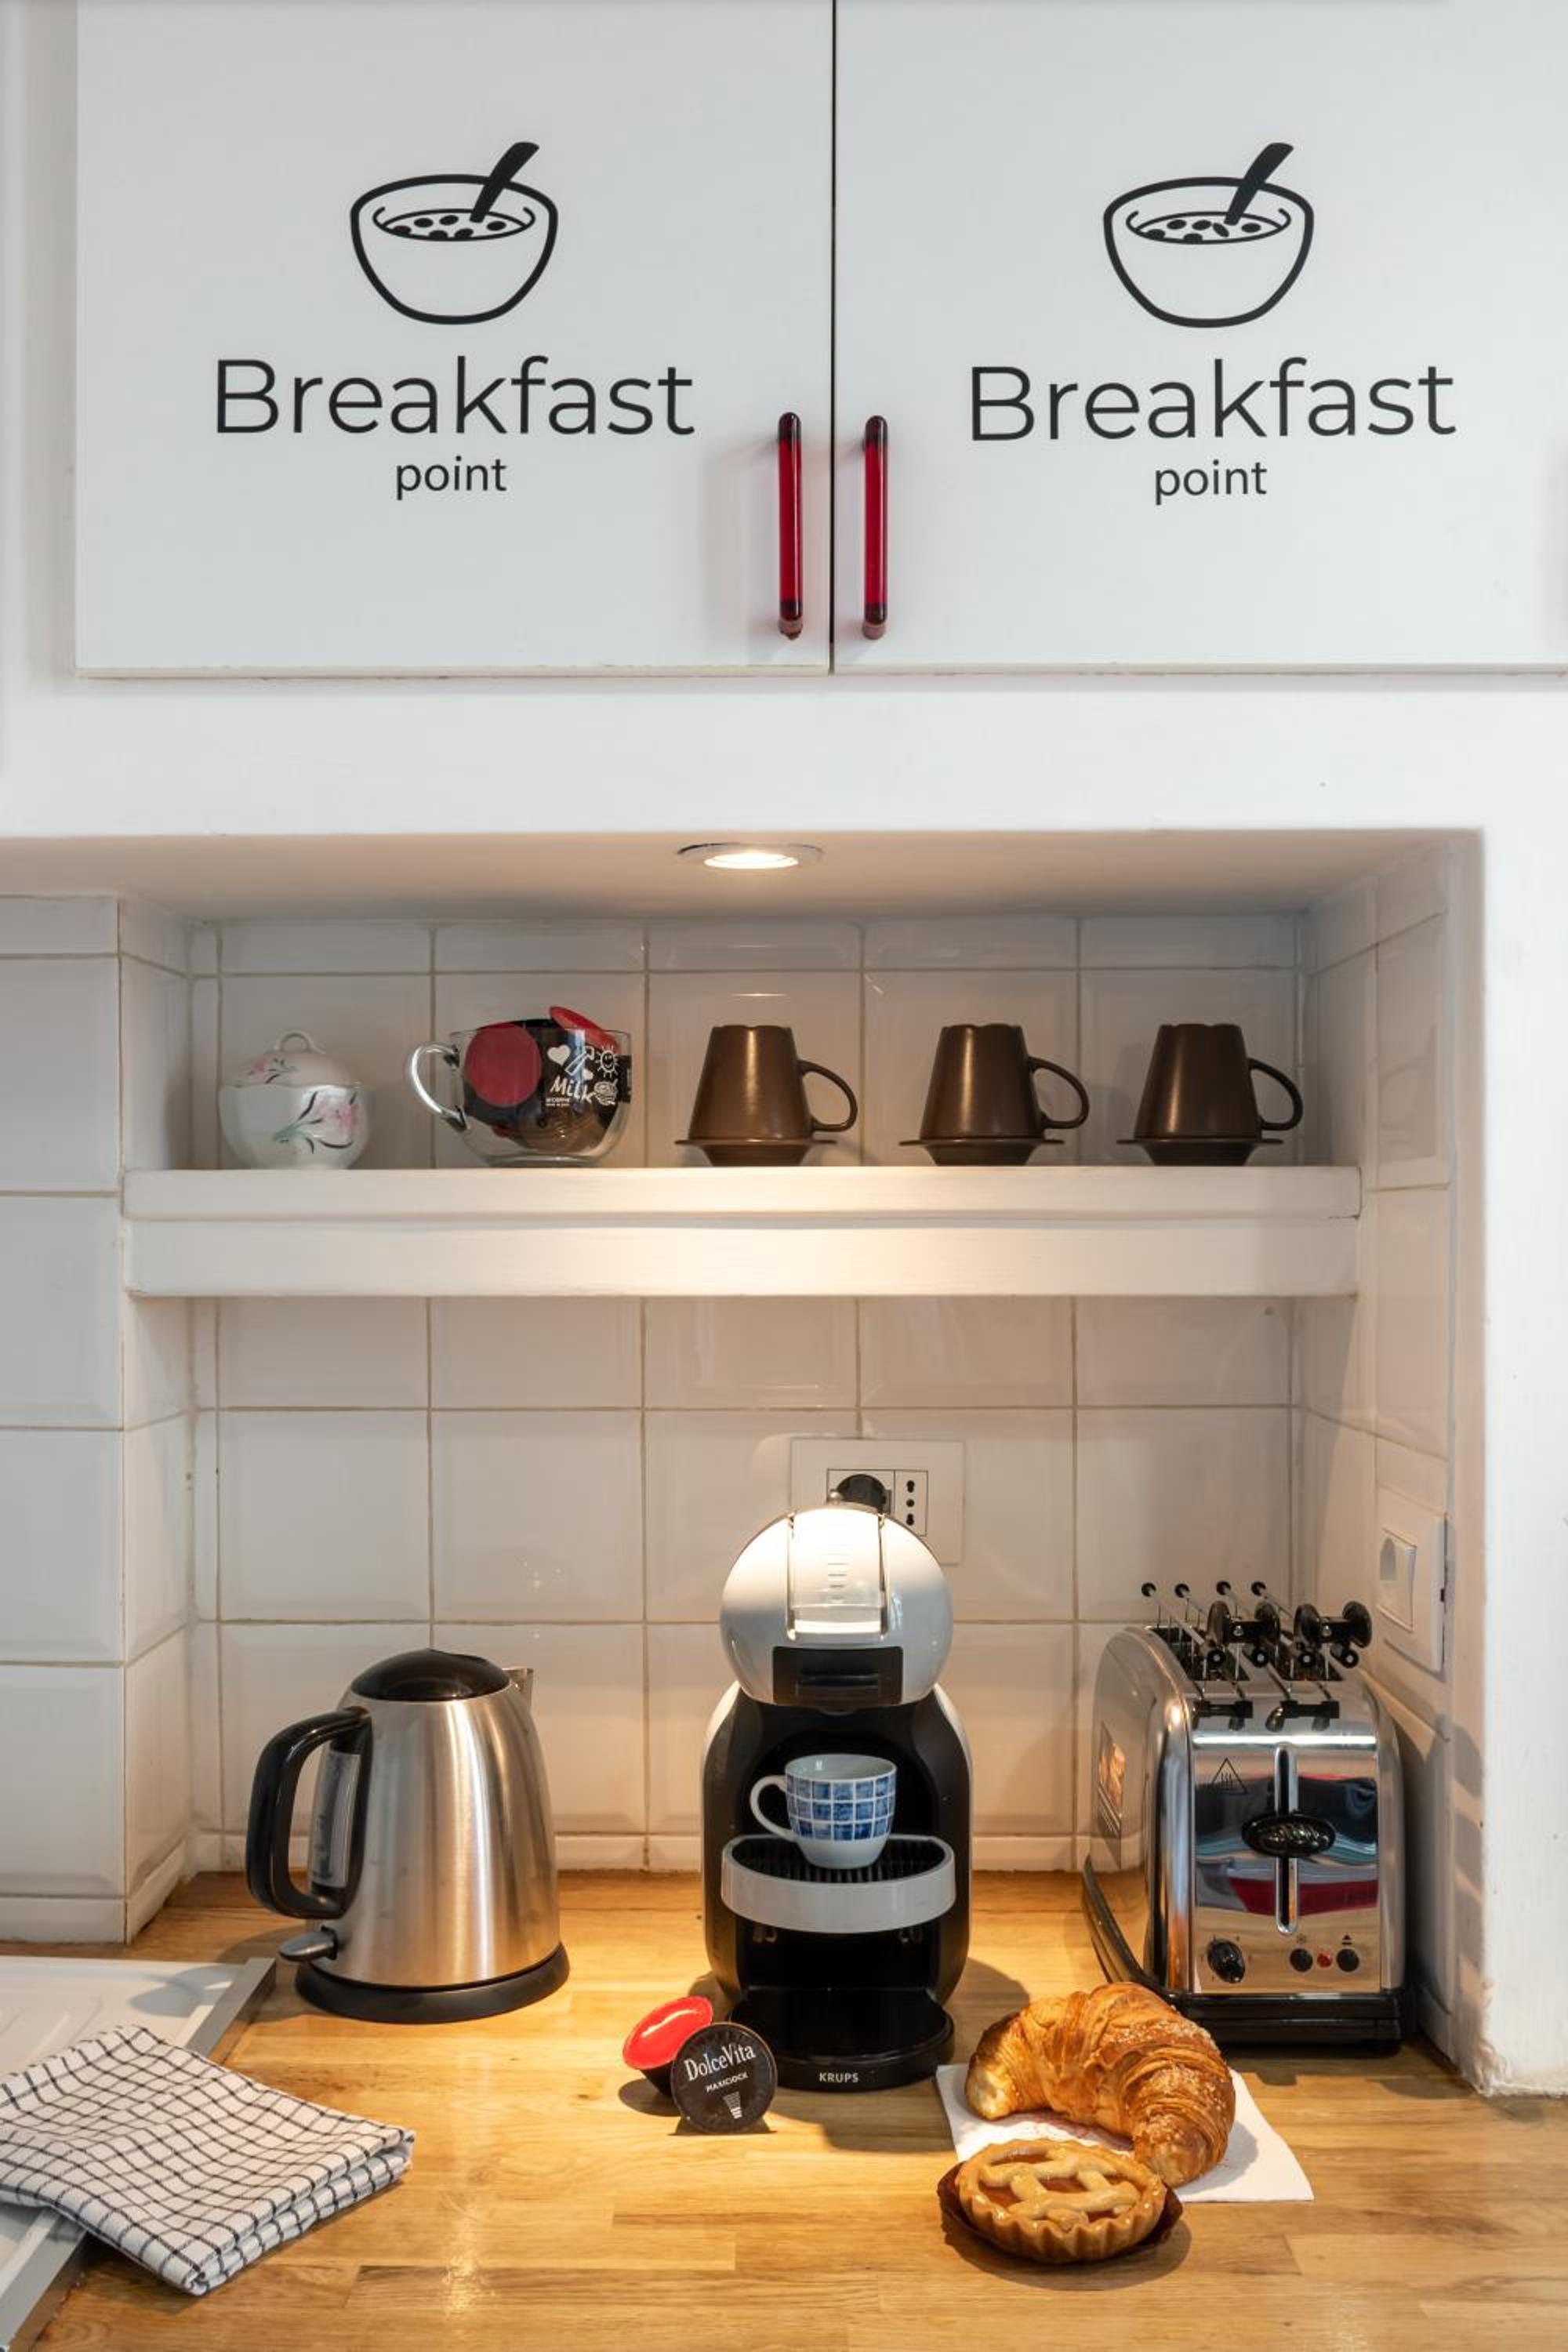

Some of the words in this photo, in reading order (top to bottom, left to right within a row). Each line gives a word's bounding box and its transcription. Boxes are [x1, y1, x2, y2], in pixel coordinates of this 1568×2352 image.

[216, 354, 696, 435] Breakfast
[971, 357, 1457, 441] Breakfast
[396, 455, 507, 501] point
[1156, 459, 1268, 506] point
[550, 1075, 596, 1104] Milk
[819, 2072, 859, 2083] KRUPS
